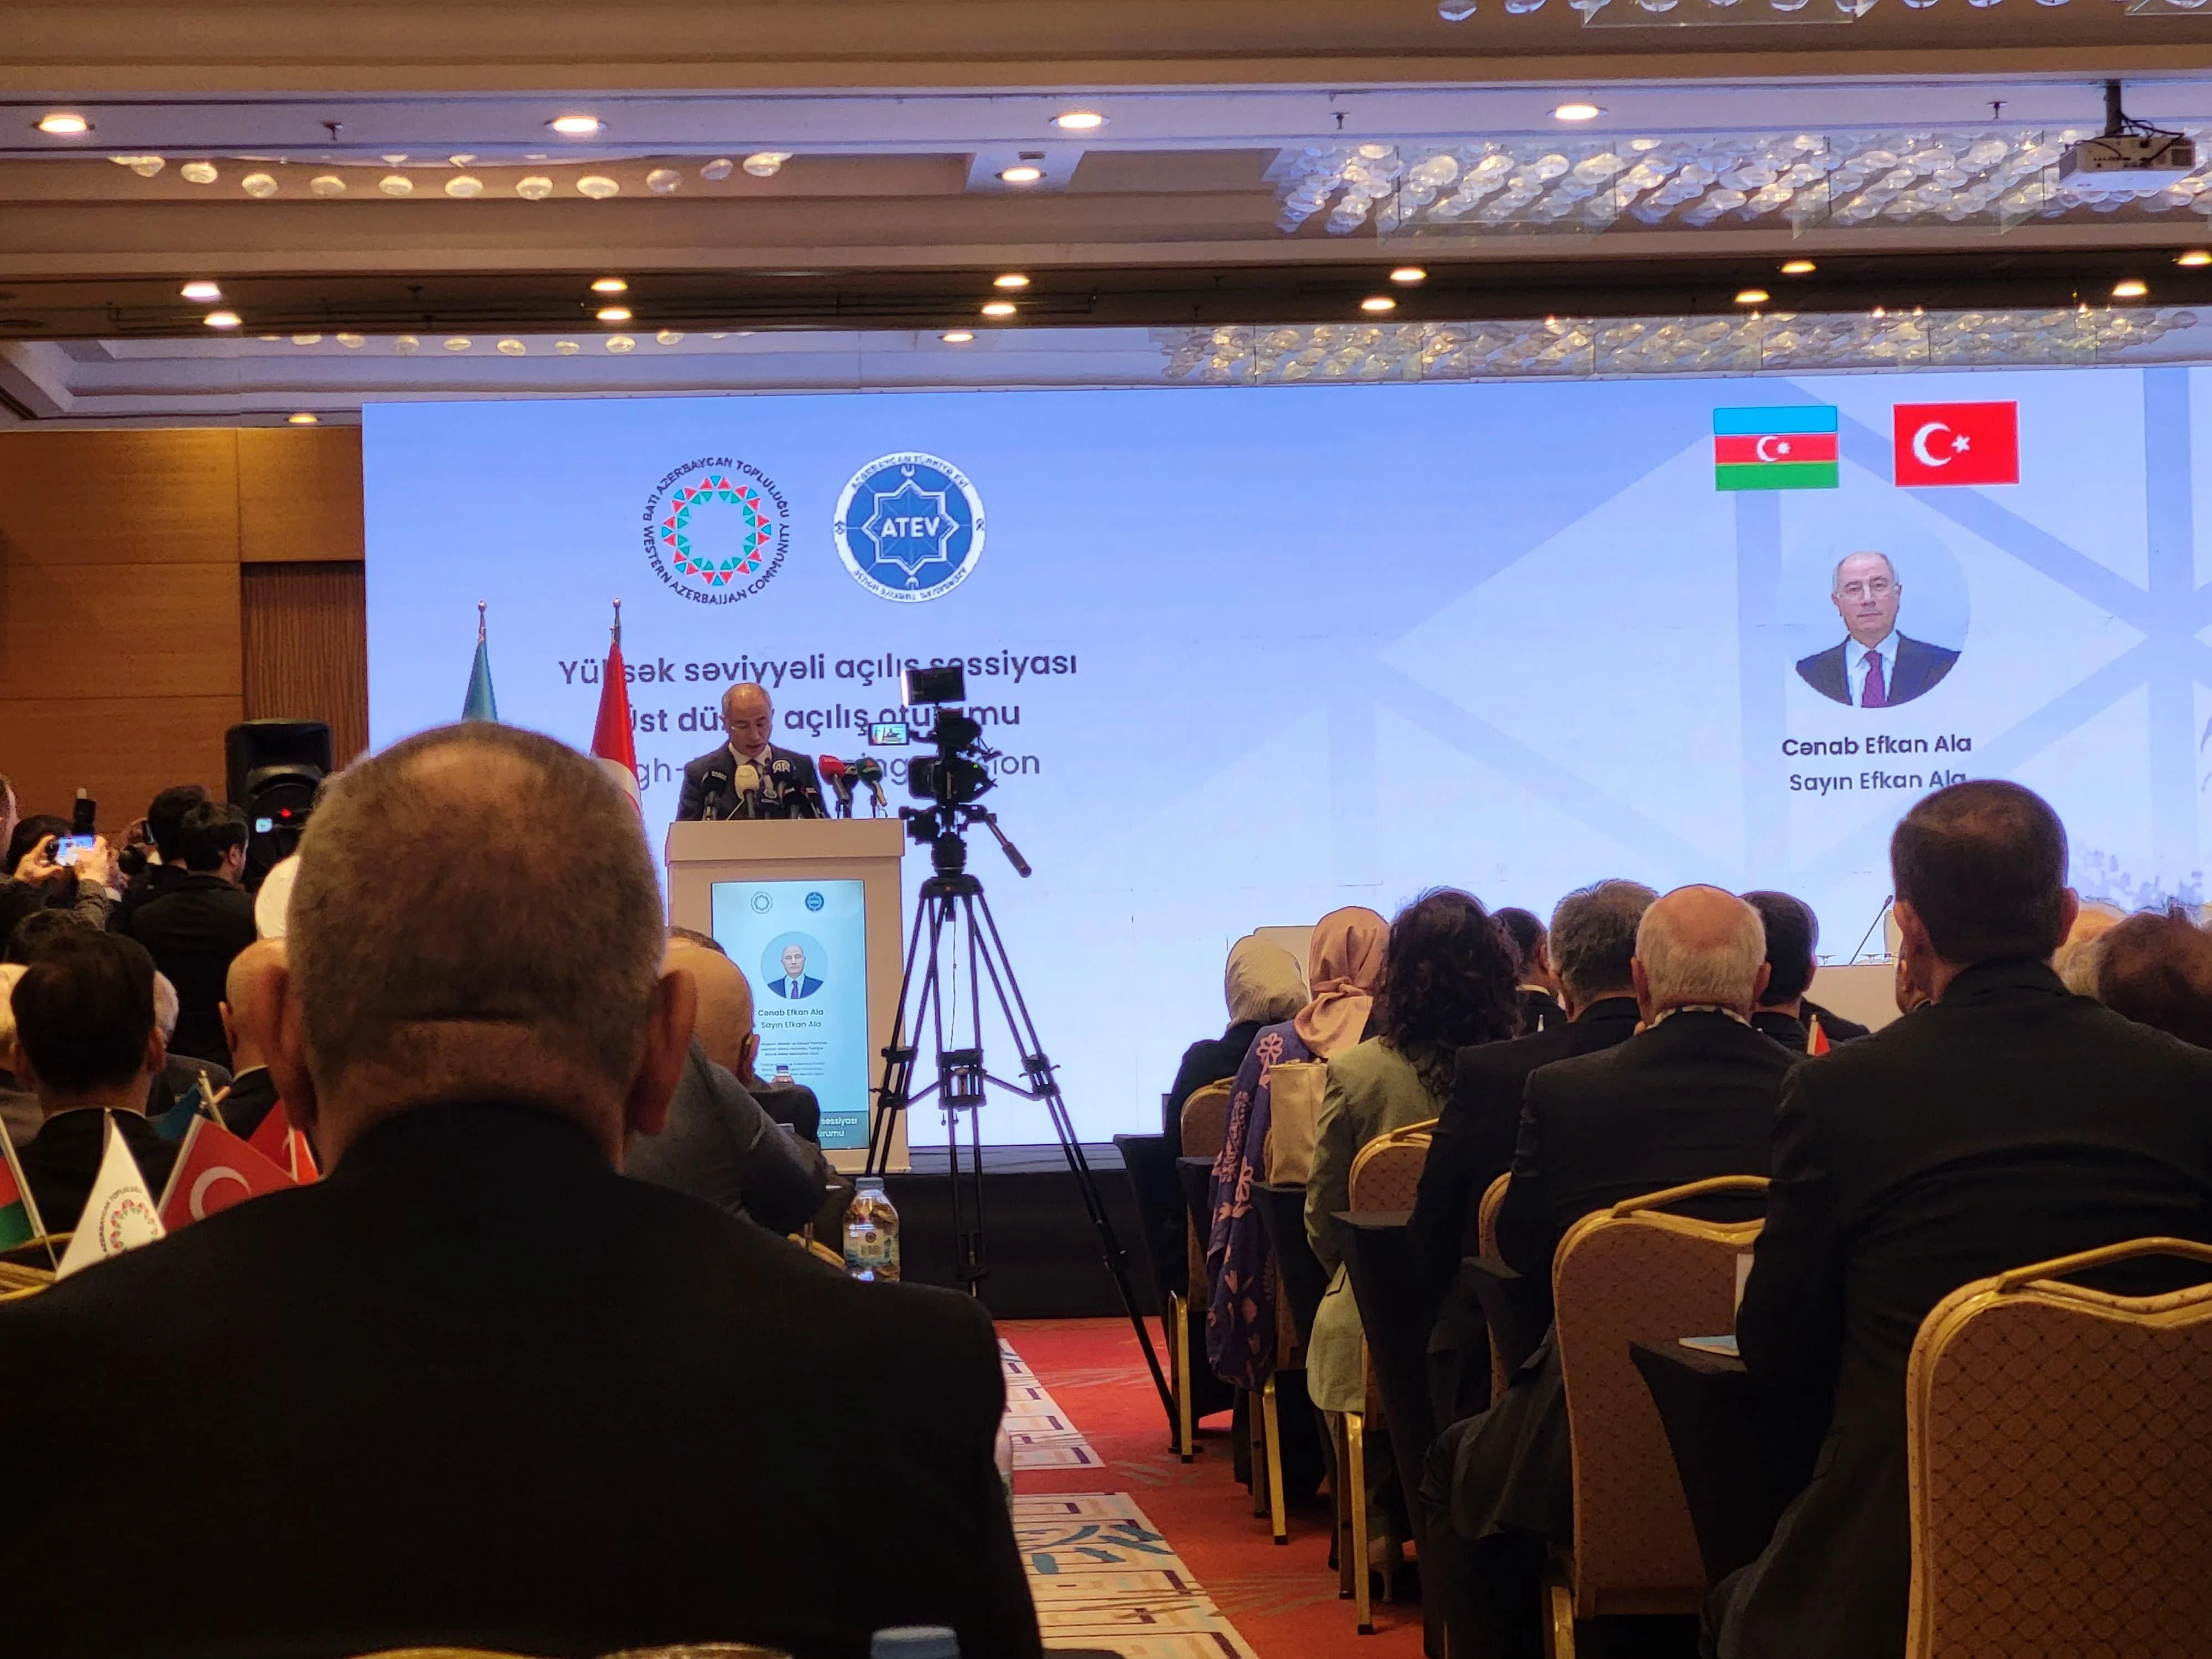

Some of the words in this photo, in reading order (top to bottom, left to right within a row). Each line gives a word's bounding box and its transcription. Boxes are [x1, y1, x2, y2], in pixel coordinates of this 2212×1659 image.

[643, 494, 660, 521] BATI
[656, 457, 733, 495] AZERBAYCAN
[736, 460, 790, 518] TOPLULUĞU
[880, 516, 940, 538] ATEV
[643, 525, 673, 583] WESTERN
[669, 581, 748, 605] AZERBAIJAN
[747, 523, 790, 595] COMMUNITY
[685, 654, 824, 688] səviyyəli
[785, 704, 868, 737] açılış
[1781, 737, 1859, 756] Cənab
[1865, 734, 1928, 754] Efkan
[1934, 734, 1972, 753] Ala
[1790, 773, 1853, 796] Sayın
[1860, 771, 1923, 790] Efkan
